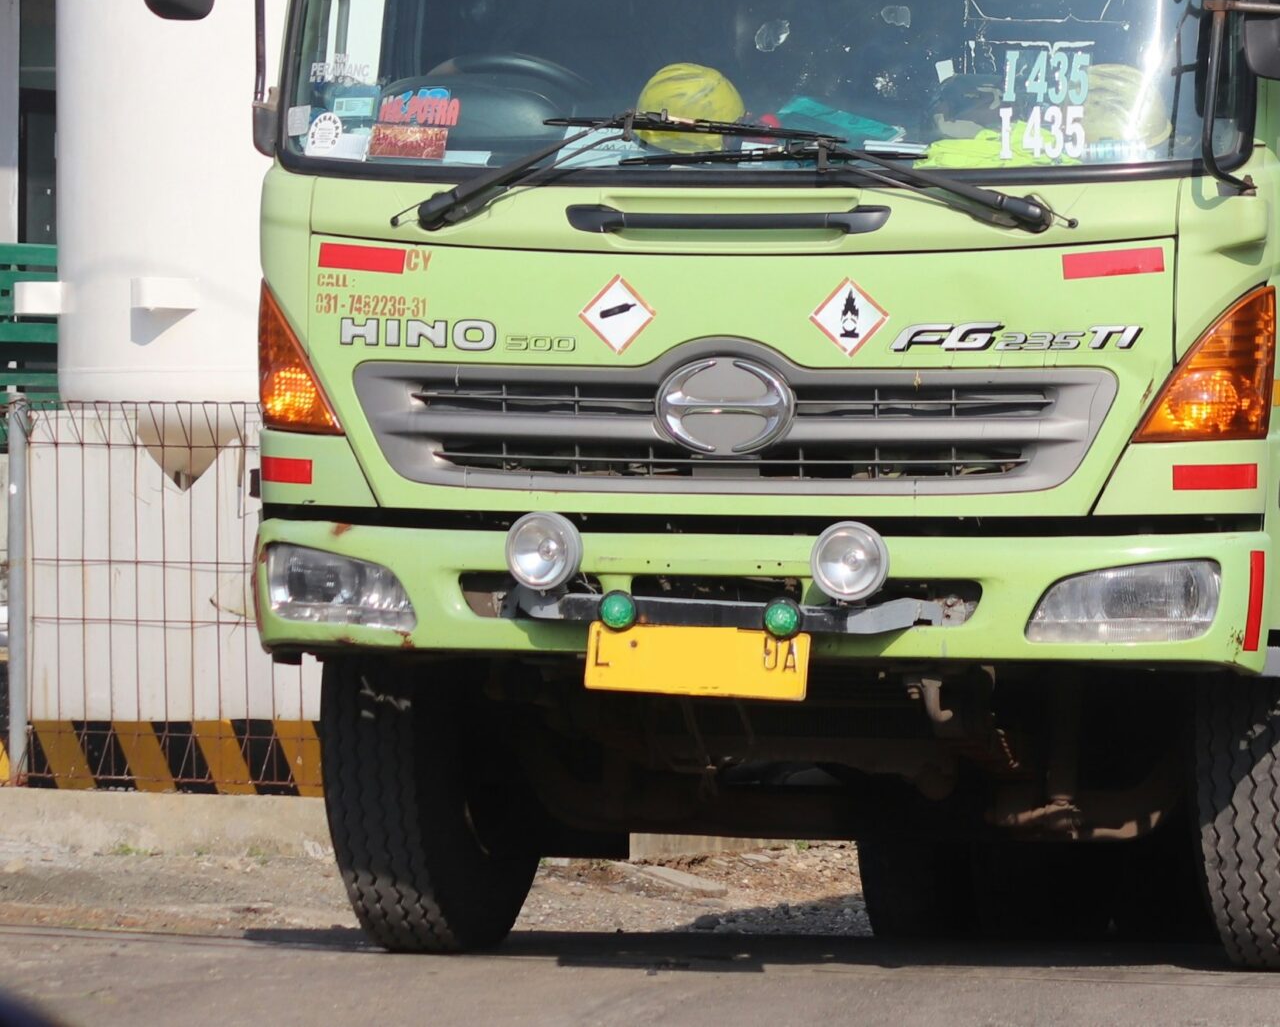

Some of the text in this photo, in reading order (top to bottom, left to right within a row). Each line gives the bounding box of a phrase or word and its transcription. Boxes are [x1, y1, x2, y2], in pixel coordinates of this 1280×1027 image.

[1026, 50, 1090, 105] 435
[1022, 106, 1086, 159] 435
[317, 273, 349, 288] CALL
[339, 317, 577, 352] HINO 500
[595, 630, 610, 667] L
